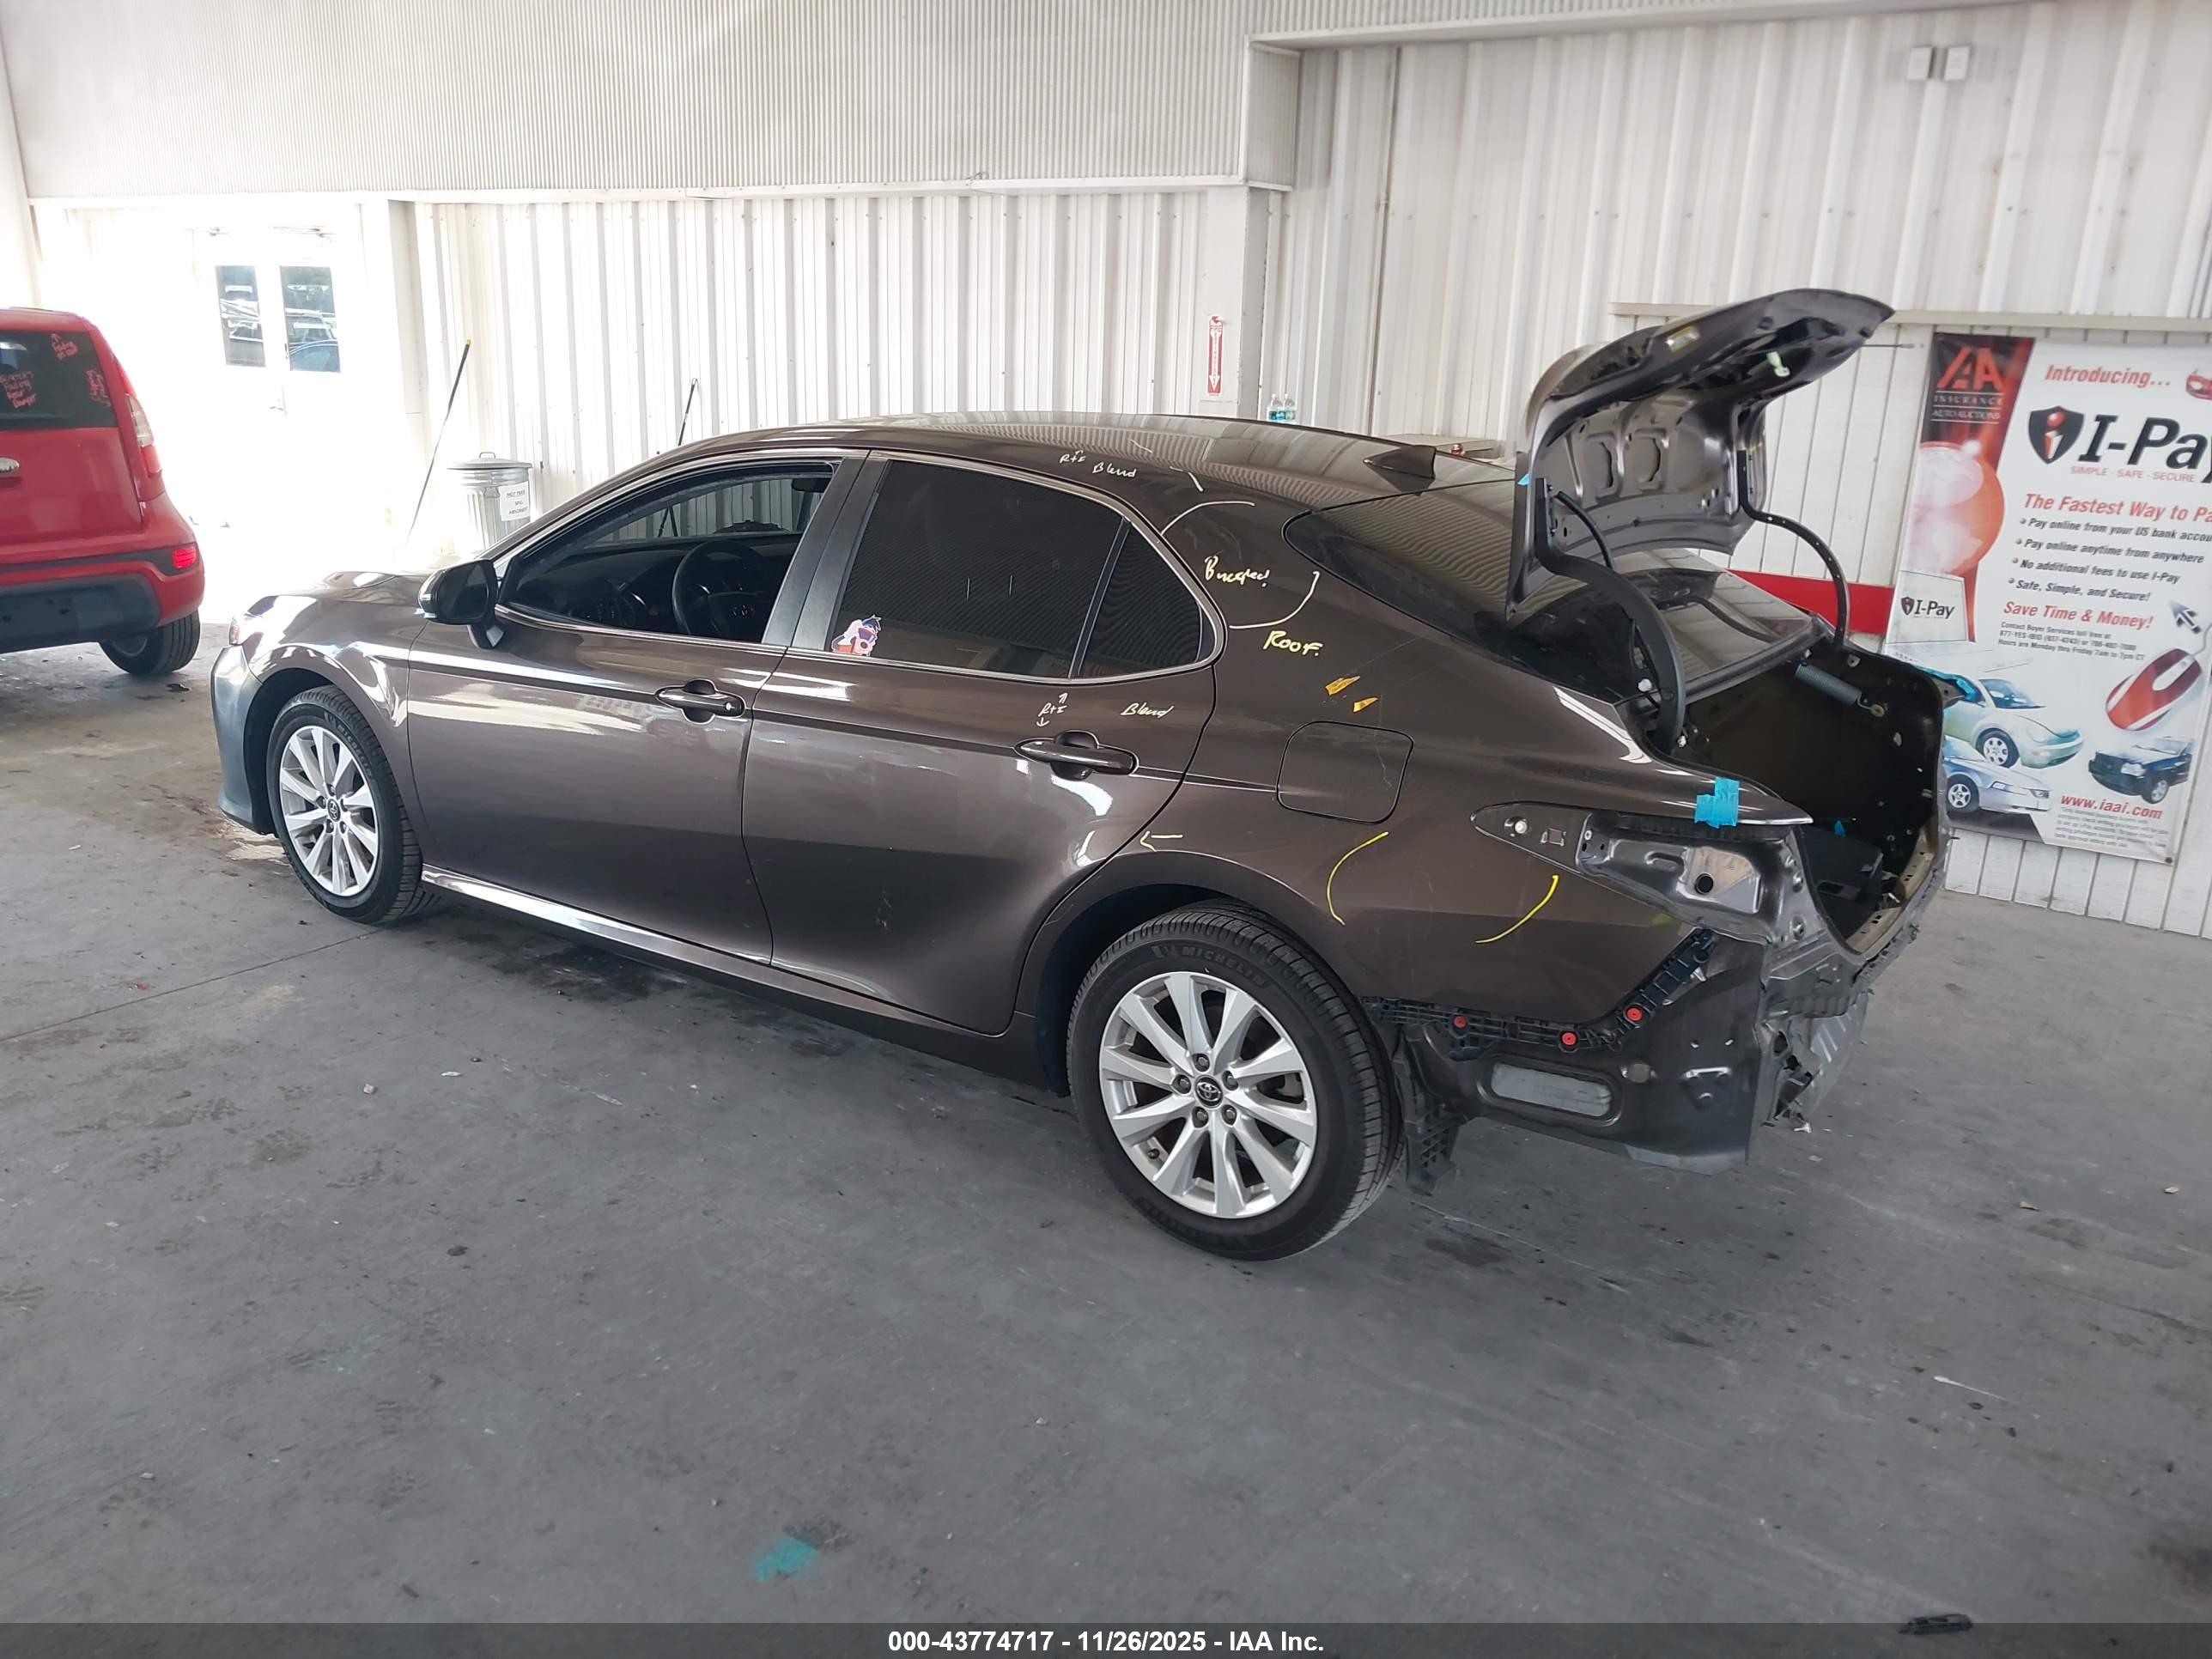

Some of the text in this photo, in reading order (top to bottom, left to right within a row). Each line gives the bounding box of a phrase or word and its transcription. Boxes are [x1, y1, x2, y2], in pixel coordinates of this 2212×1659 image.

[2045, 365, 2170, 388] Introducing...
[2070, 465, 2196, 482] SIMPLE SAFE SECURE
[2024, 493, 2054, 510] The
[2058, 495, 2124, 515] Fastest
[2129, 501, 2166, 521] Way
[2170, 505, 2188, 520] to
[2028, 518, 2047, 529] Pay
[2049, 520, 2081, 530] online
[2083, 523, 2106, 533] from
[2109, 526, 2133, 536] your
[2136, 526, 2148, 536] US
[2151, 528, 2177, 538] bank
[2024, 538, 2204, 563] Pay online anytime from anywhere
[2020, 560, 2181, 585] No additional fees to use I-Pay
[2015, 579, 2151, 601] Safe, Simple, and Secure!
[1914, 599, 1955, 619] I-Pay
[2003, 600, 2154, 630] Save Time & Money!
[2061, 795, 2163, 819] www.iaai.com
[1181, 946, 1267, 988] MICHELIN
